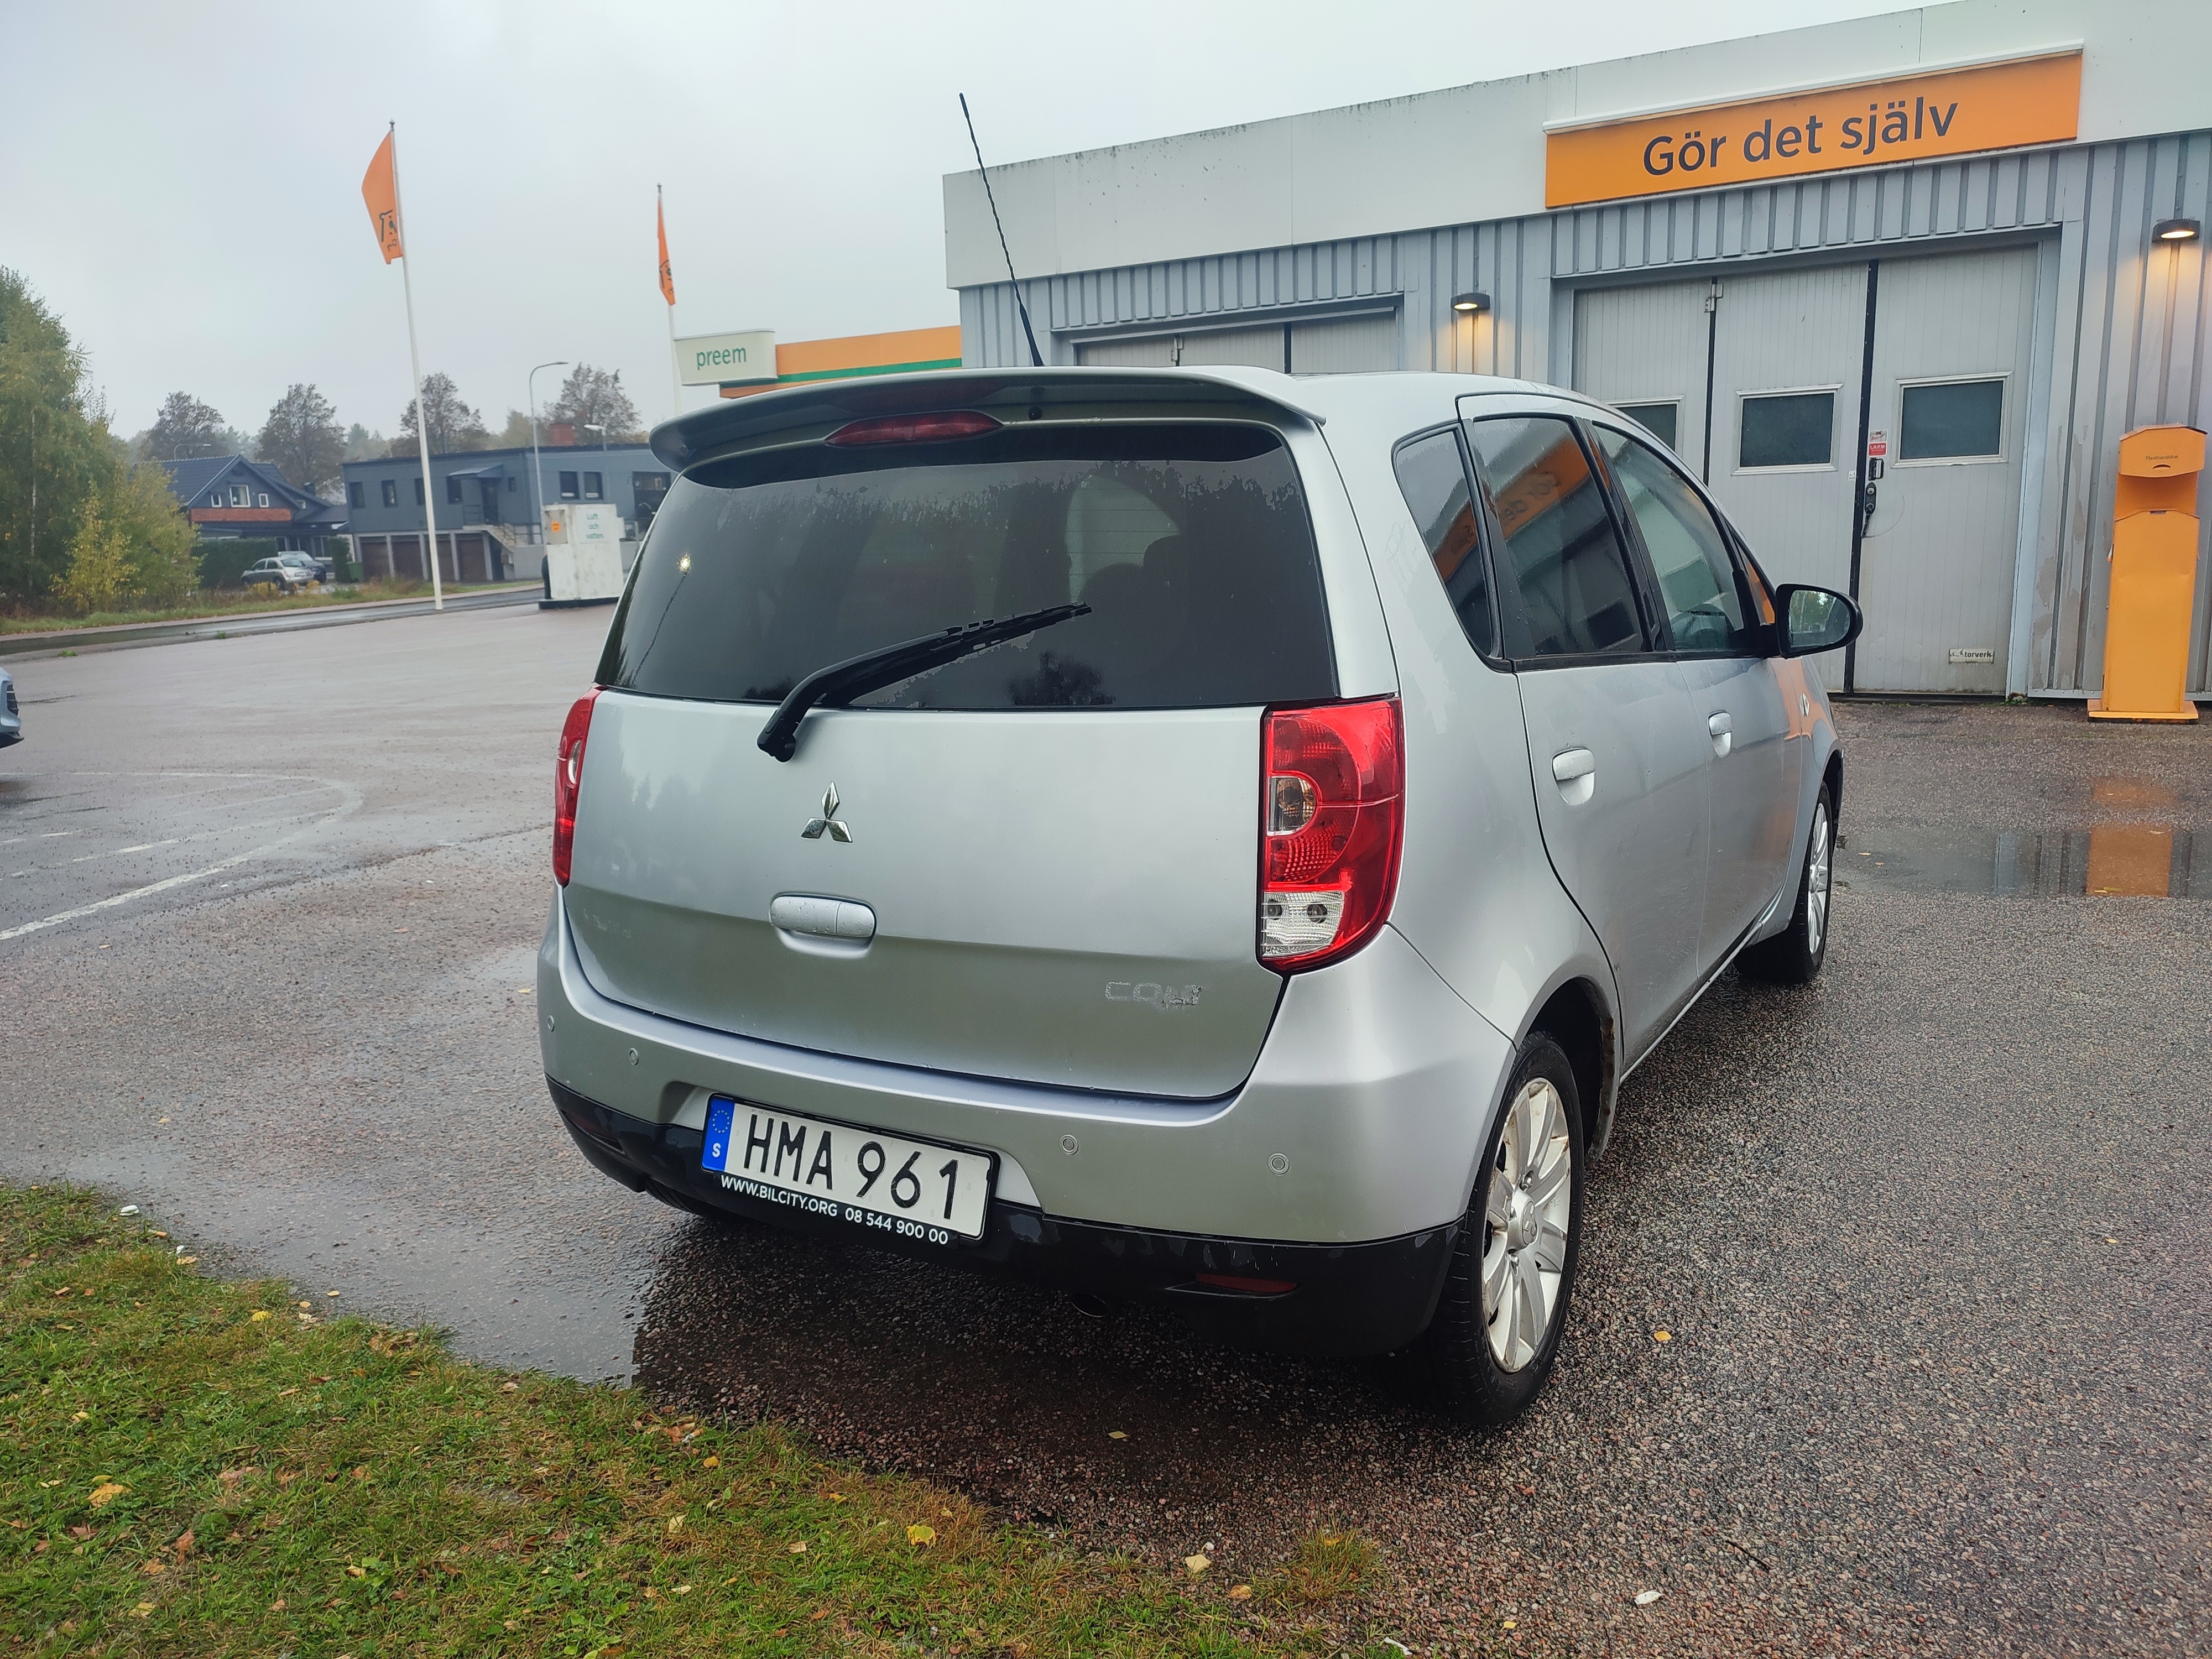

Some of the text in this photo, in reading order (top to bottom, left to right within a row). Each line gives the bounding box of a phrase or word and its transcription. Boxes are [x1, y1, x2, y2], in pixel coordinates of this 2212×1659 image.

[1643, 96, 1958, 176] Gör det själv
[696, 347, 747, 371] preem
[712, 1142, 721, 1158] S
[743, 1114, 959, 1220] HMA 961
[721, 1175, 949, 1245] WWW.BILCITY.ORG 08 544 900 00
